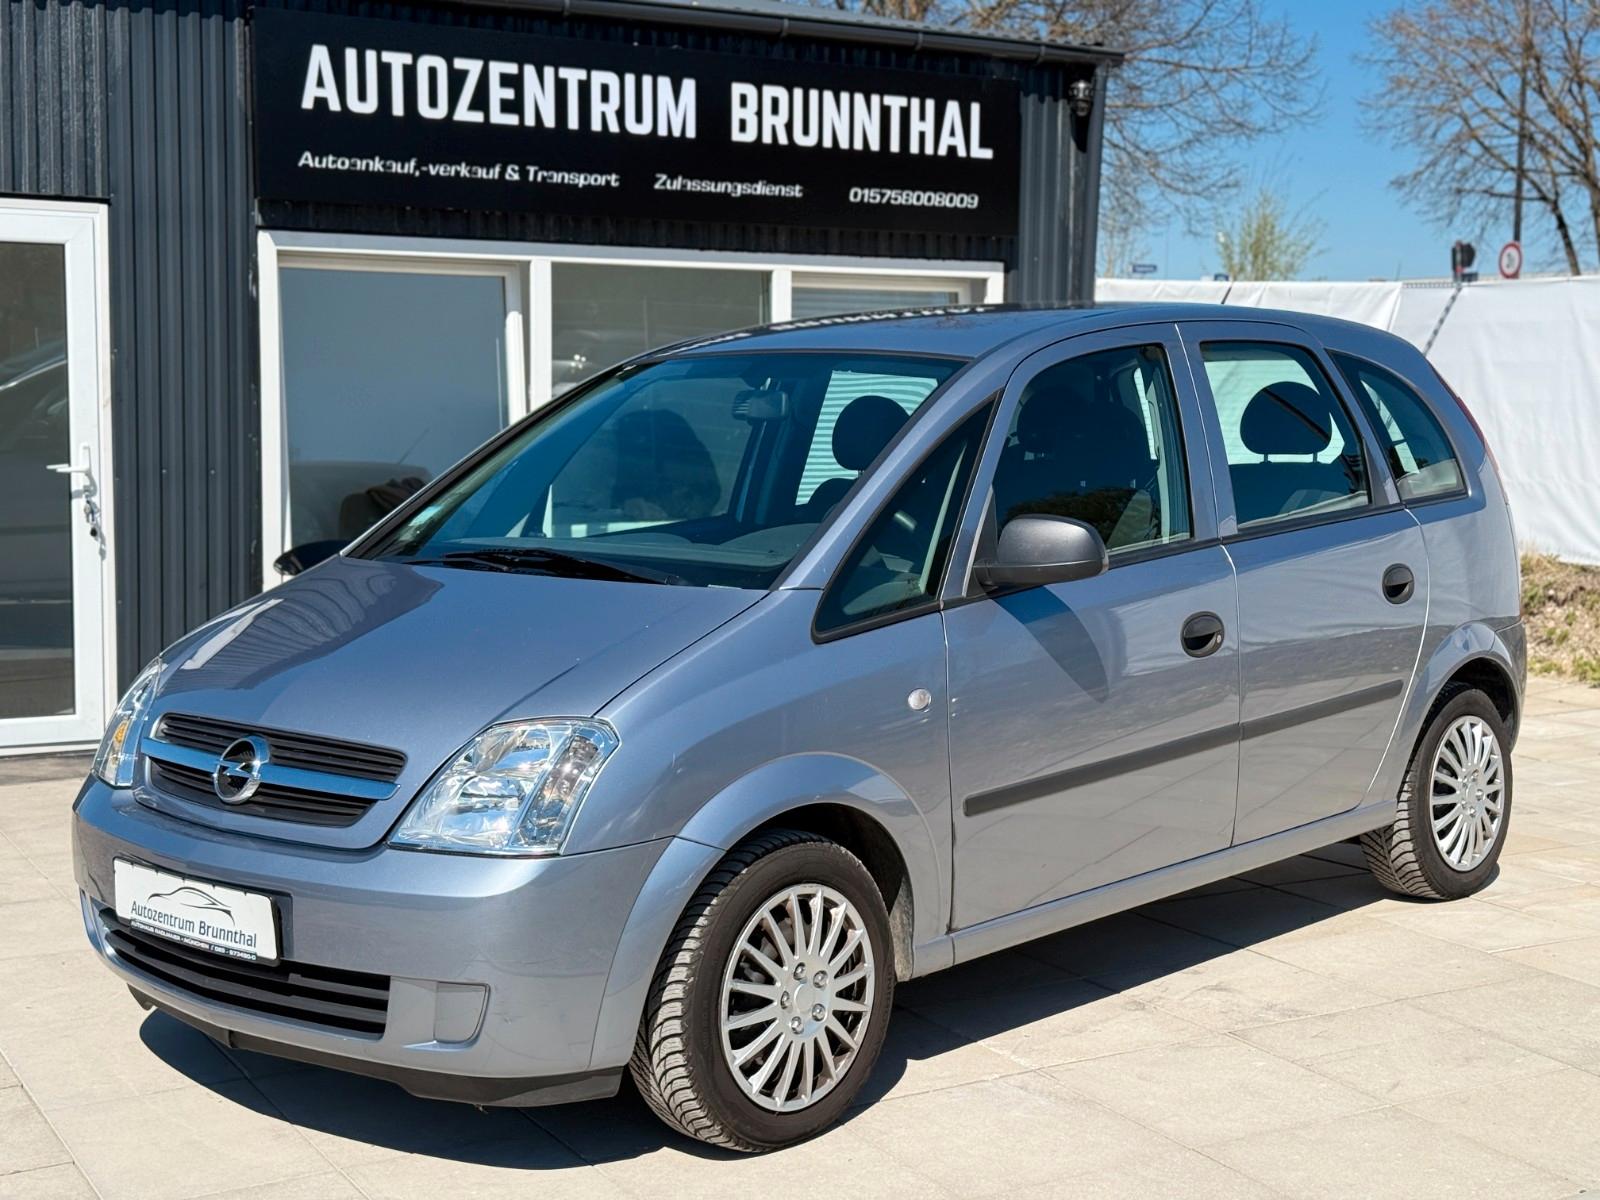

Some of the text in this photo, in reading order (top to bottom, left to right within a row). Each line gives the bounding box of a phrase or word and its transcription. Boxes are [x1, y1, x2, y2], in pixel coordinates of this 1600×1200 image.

[300, 43, 994, 160] AUTOZENTRUM BRUNNTHAL
[504, 164, 522, 181] &
[526, 165, 620, 188] Transport
[653, 173, 804, 198] Zulassungsdienst
[848, 187, 980, 209] 015758008009
[131, 900, 195, 933] Autozentrum
[199, 920, 257, 949] Brunnthal
